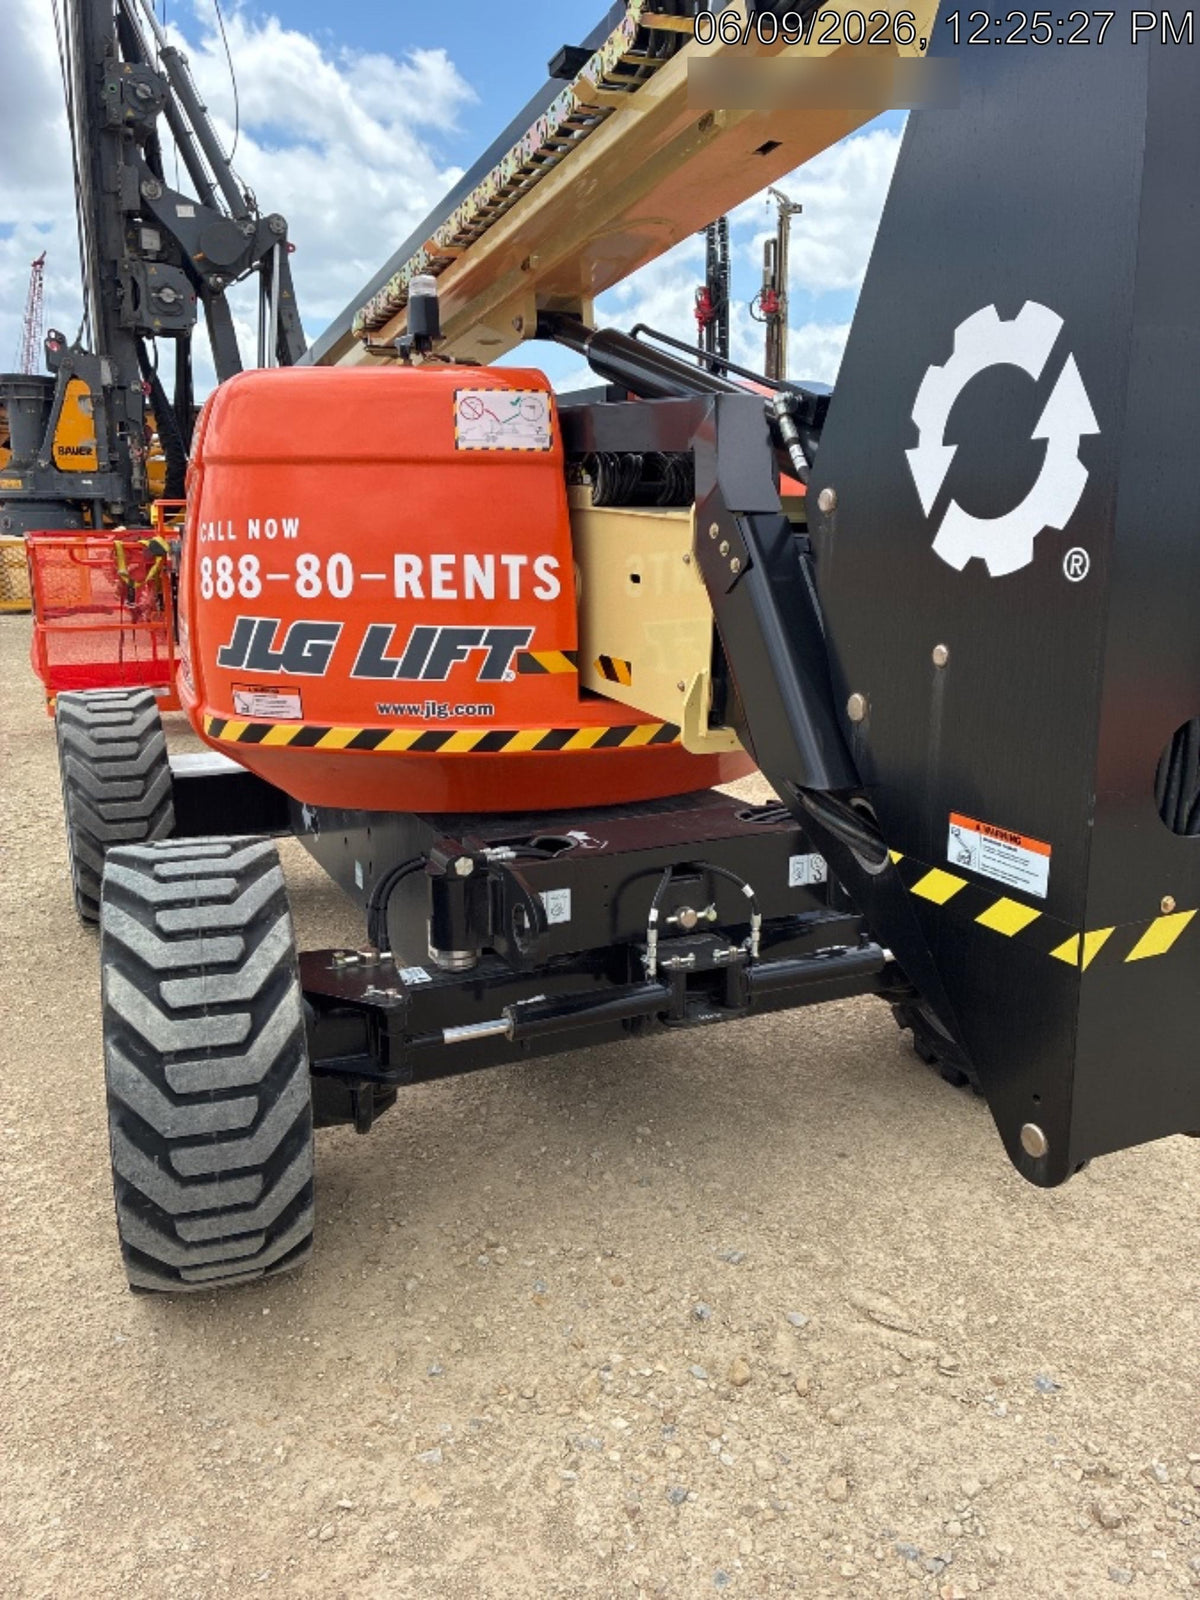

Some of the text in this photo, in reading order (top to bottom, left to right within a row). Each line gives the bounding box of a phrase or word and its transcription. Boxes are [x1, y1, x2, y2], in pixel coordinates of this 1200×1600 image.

[200, 517, 299, 543] CALL NOW
[200, 552, 561, 600] 888-80-RENTS
[216, 615, 345, 676] JLG
[377, 701, 494, 718] www.jlg.com
